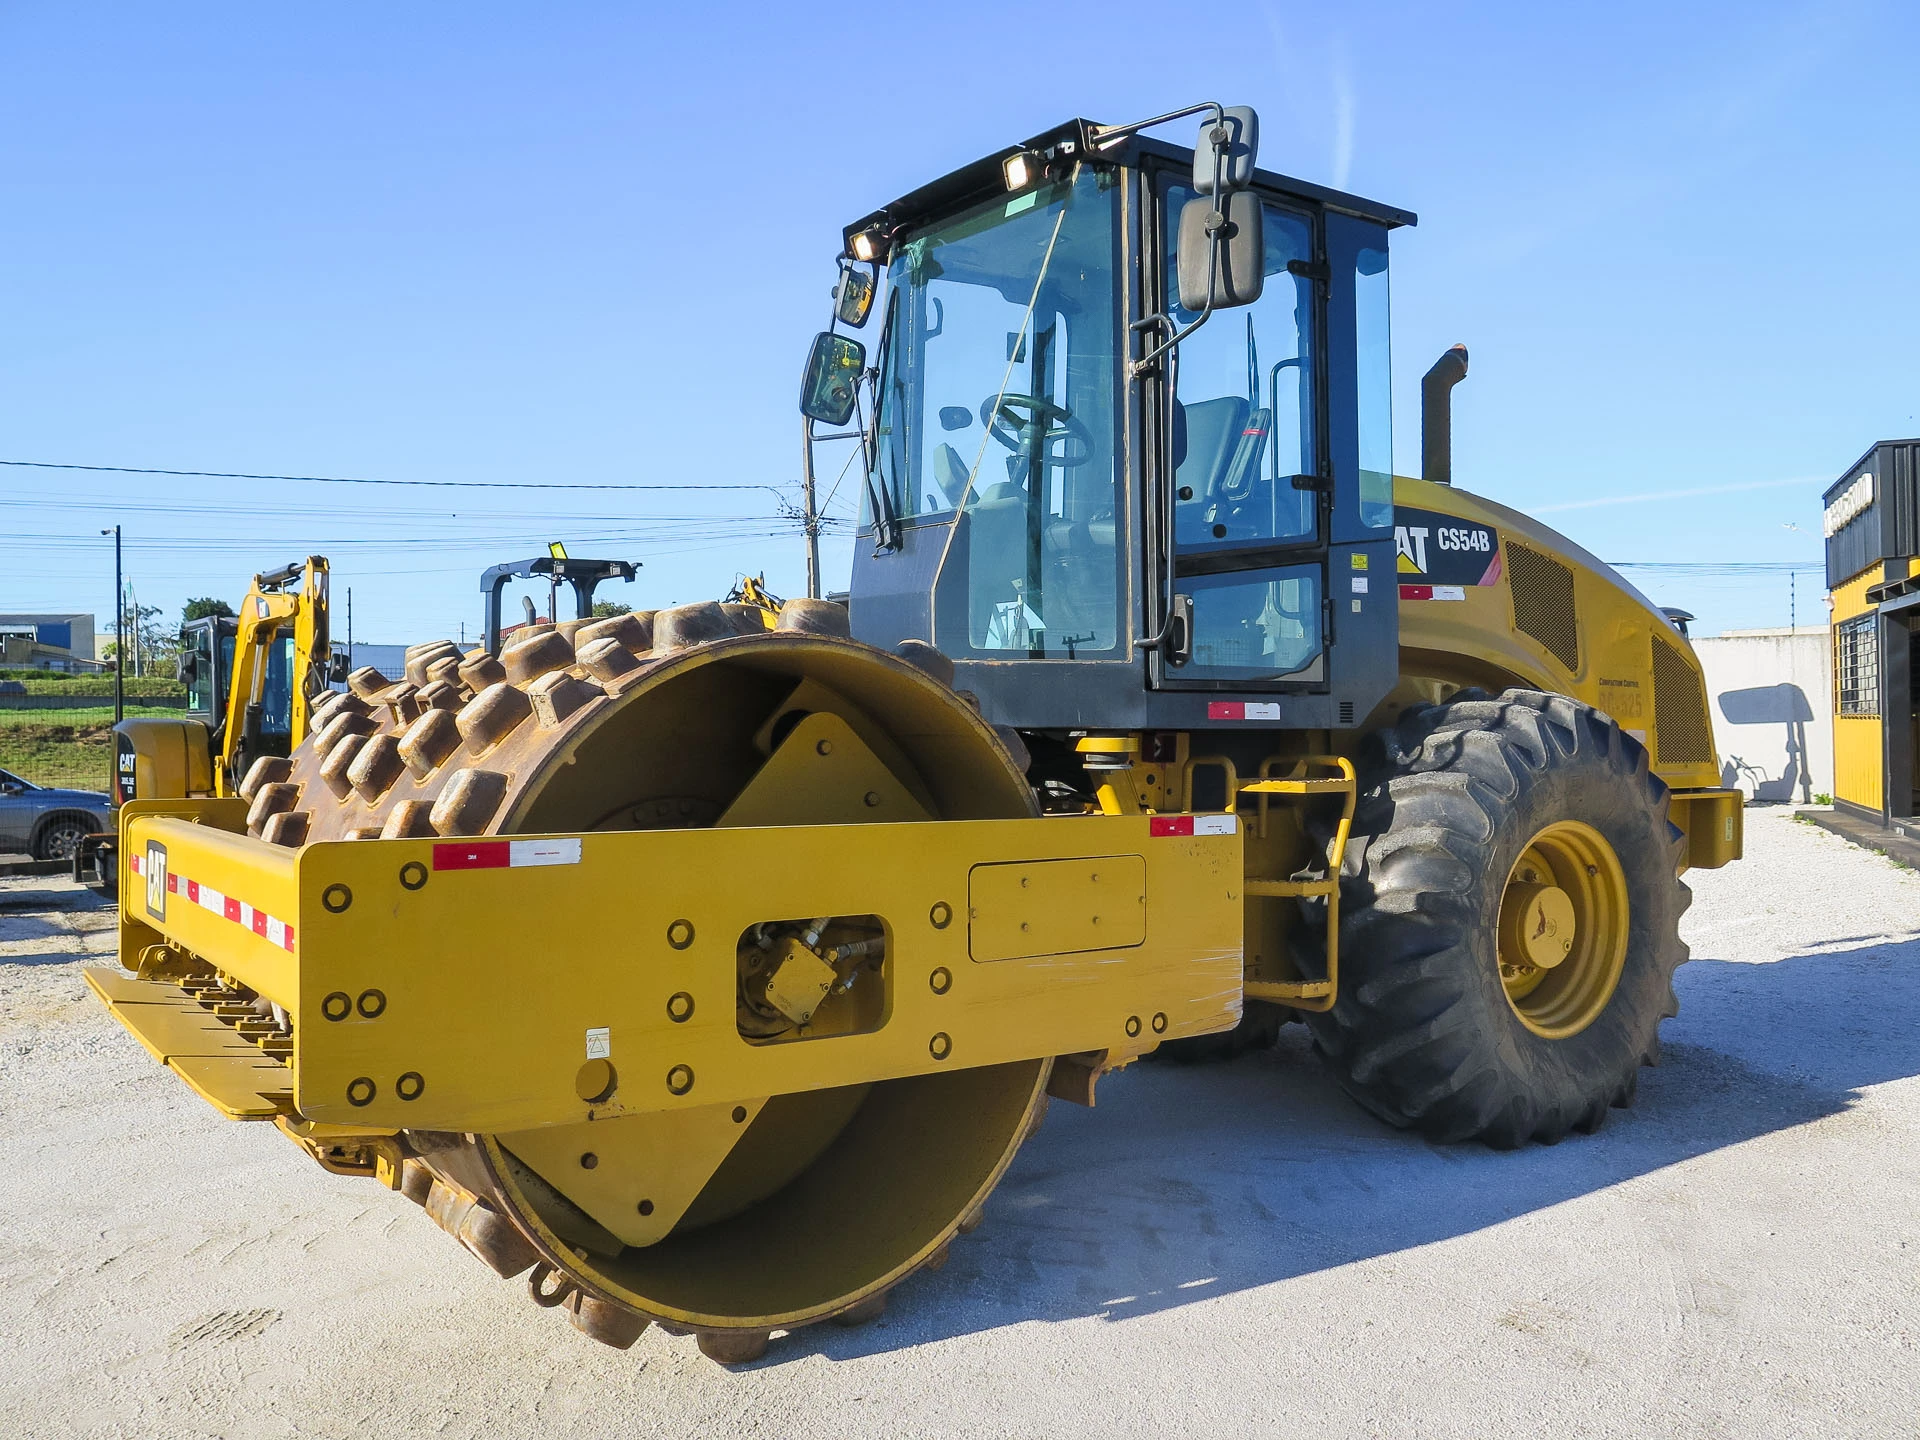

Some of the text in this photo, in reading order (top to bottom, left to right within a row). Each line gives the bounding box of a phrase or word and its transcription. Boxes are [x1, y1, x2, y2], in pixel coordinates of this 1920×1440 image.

[1394, 526, 1429, 574] AT
[1437, 527, 1490, 552] CS54B
[119, 753, 136, 772] CAT
[148, 848, 166, 914] CAT
